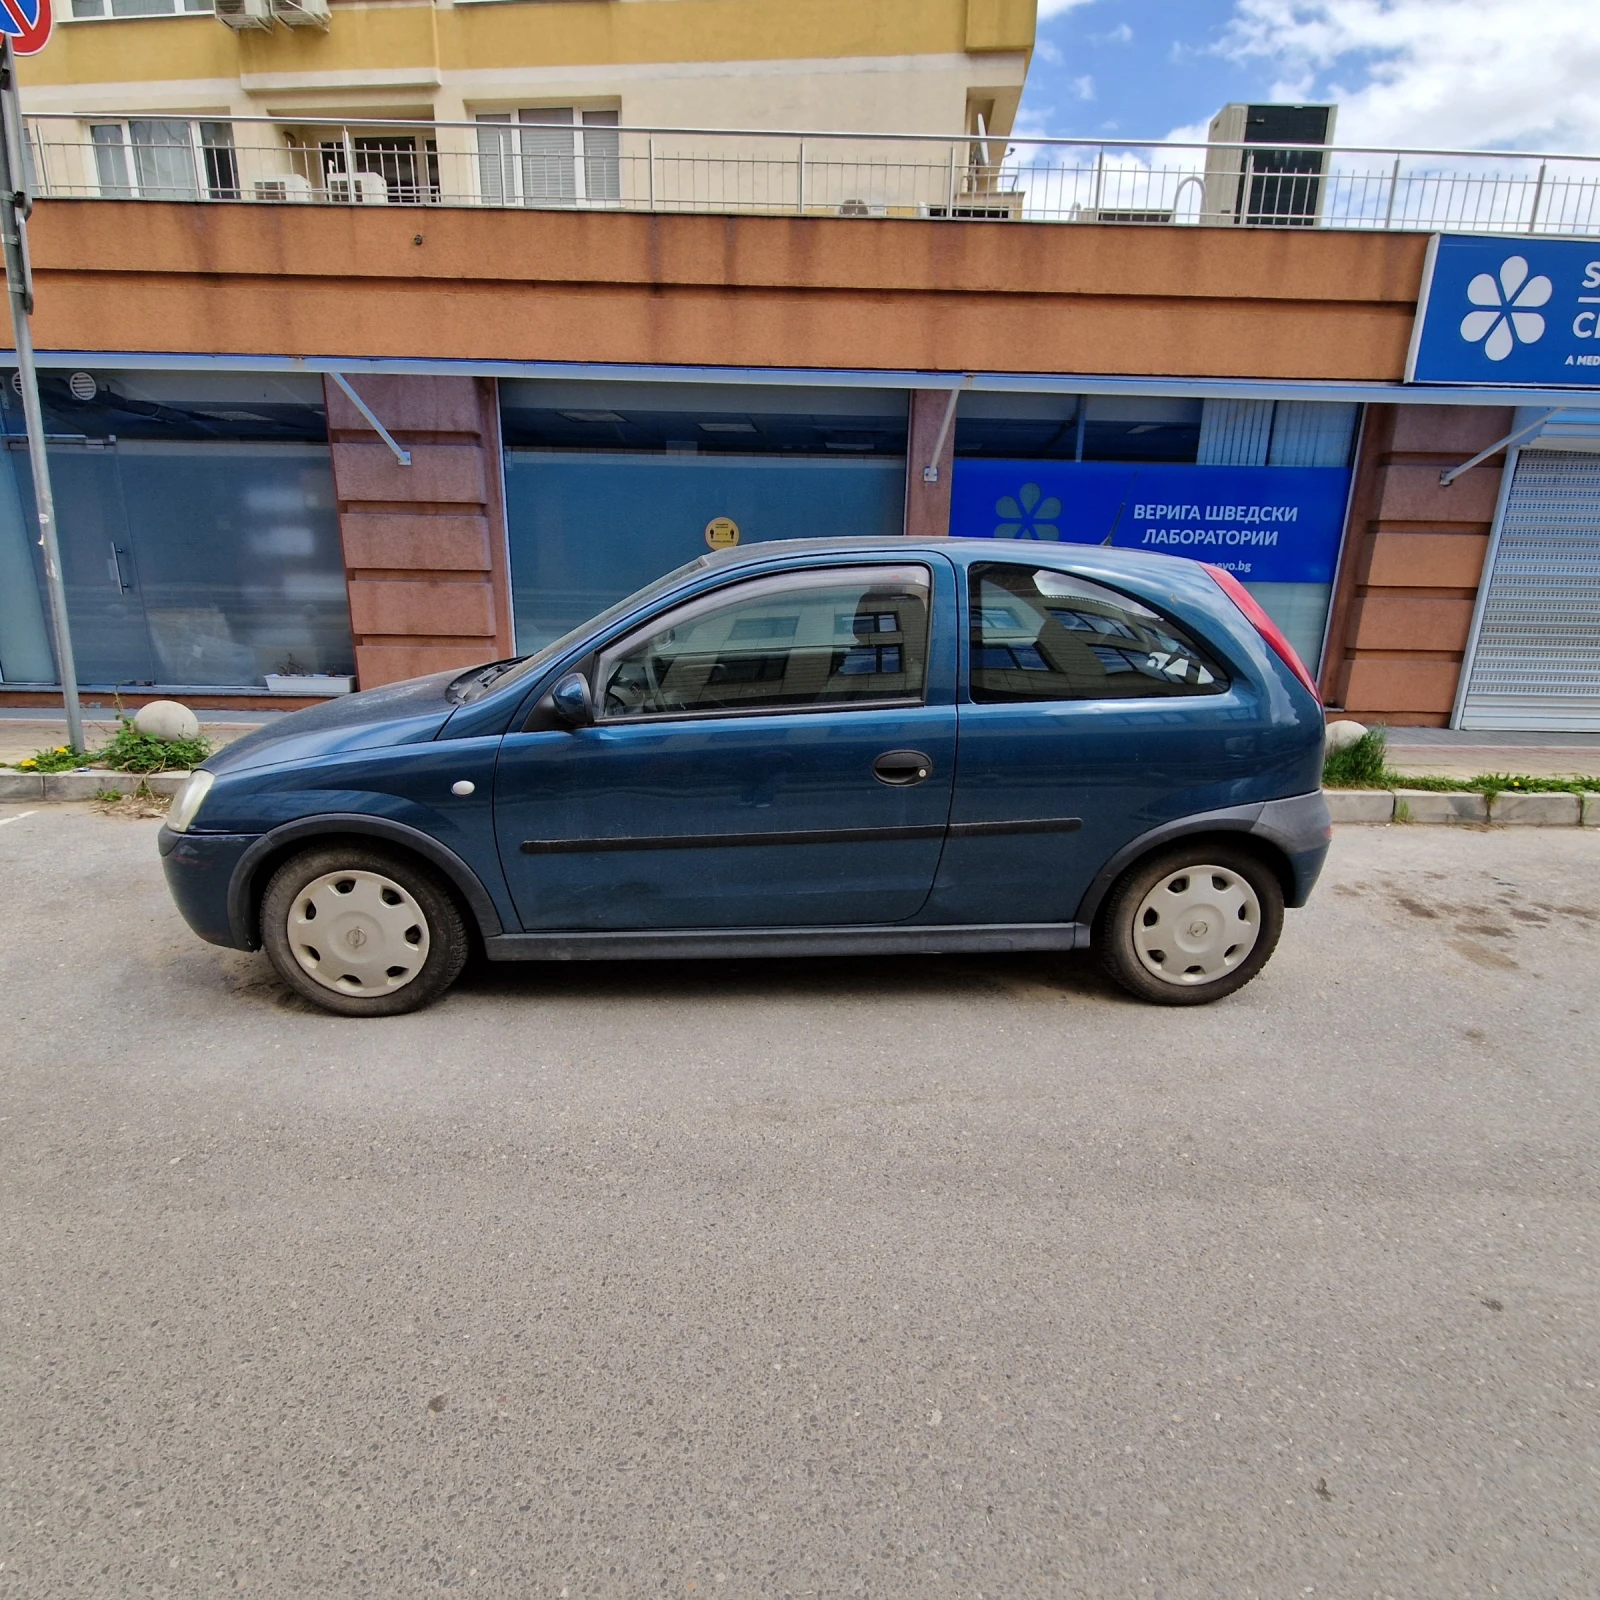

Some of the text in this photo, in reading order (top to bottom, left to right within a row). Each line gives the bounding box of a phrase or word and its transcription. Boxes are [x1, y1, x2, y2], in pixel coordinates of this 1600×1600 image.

[1565, 355, 1574, 365] A
[1133, 504, 1298, 524] ВЕРИГА ШВЕДСКИ
[1142, 529, 1278, 546] ЛАБОРАТОРИИ
